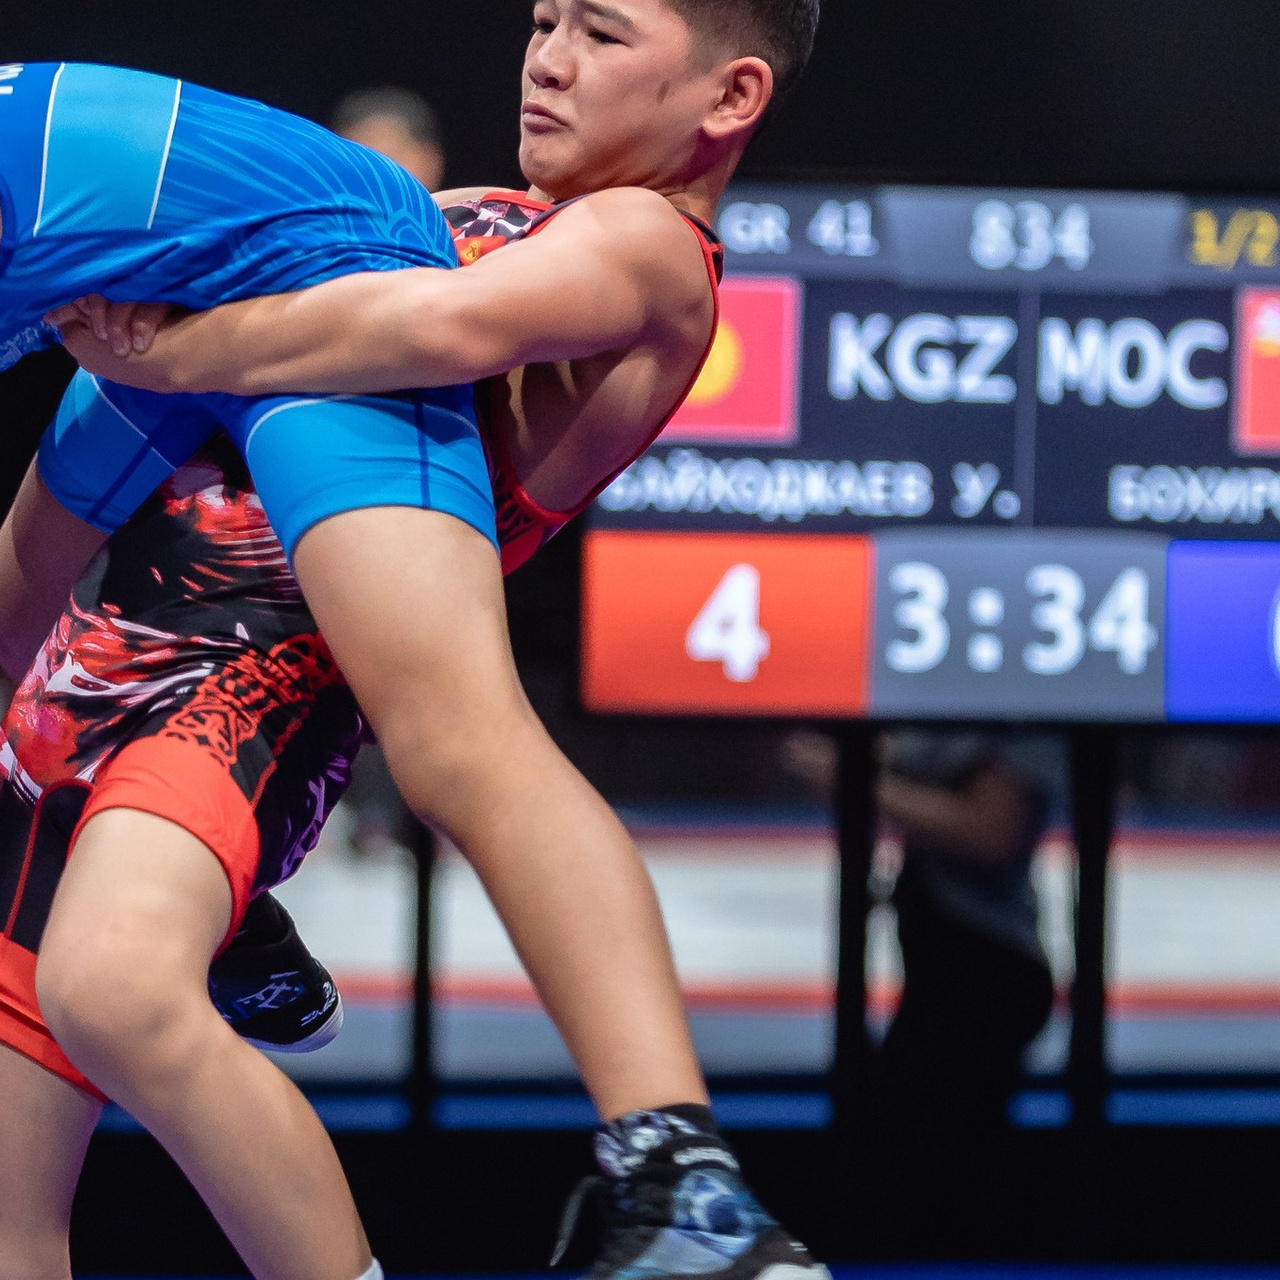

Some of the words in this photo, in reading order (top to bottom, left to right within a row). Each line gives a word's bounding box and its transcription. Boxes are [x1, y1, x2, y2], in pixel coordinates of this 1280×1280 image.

[719, 201, 791, 254] GR
[807, 200, 880, 257] 41
[968, 199, 1092, 270] 834
[1189, 209, 1278, 271] 1/2
[828, 312, 1017, 403] KGZ
[686, 562, 771, 683] 4
[885, 562, 1156, 675] 3:34
